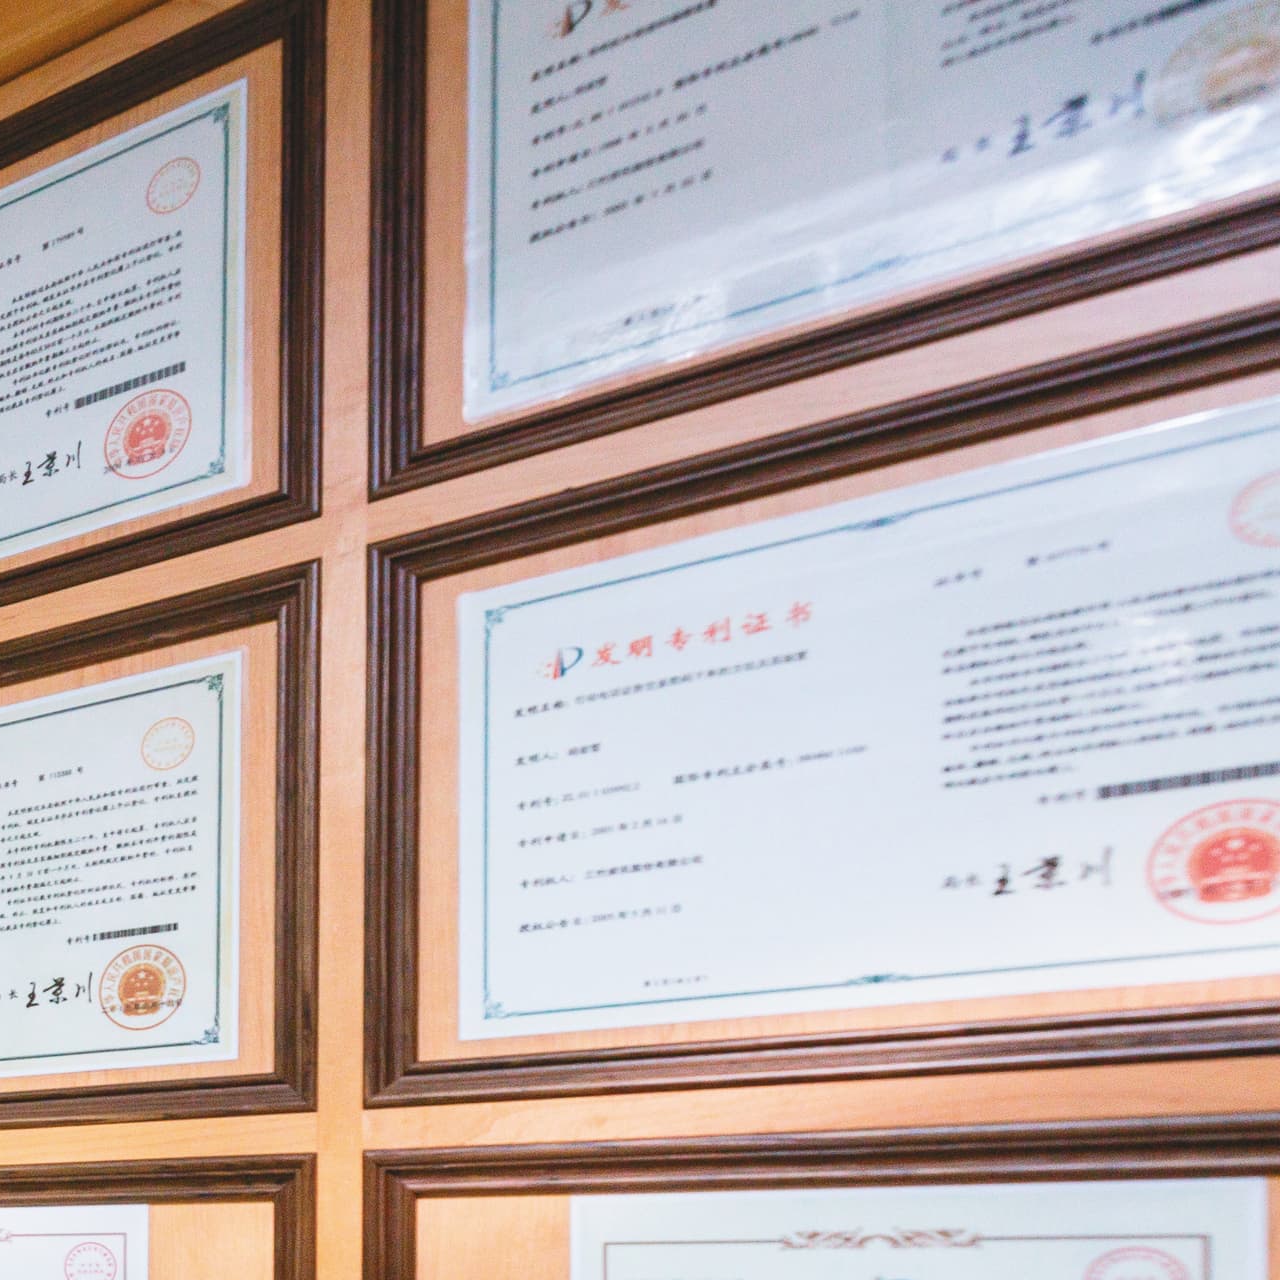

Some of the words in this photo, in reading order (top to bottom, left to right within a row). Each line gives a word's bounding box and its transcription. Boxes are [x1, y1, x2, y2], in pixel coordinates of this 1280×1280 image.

[22, 440, 82, 485] 王景川
[592, 601, 813, 668] 发明专利证书
[26, 972, 93, 1009] 王景川
